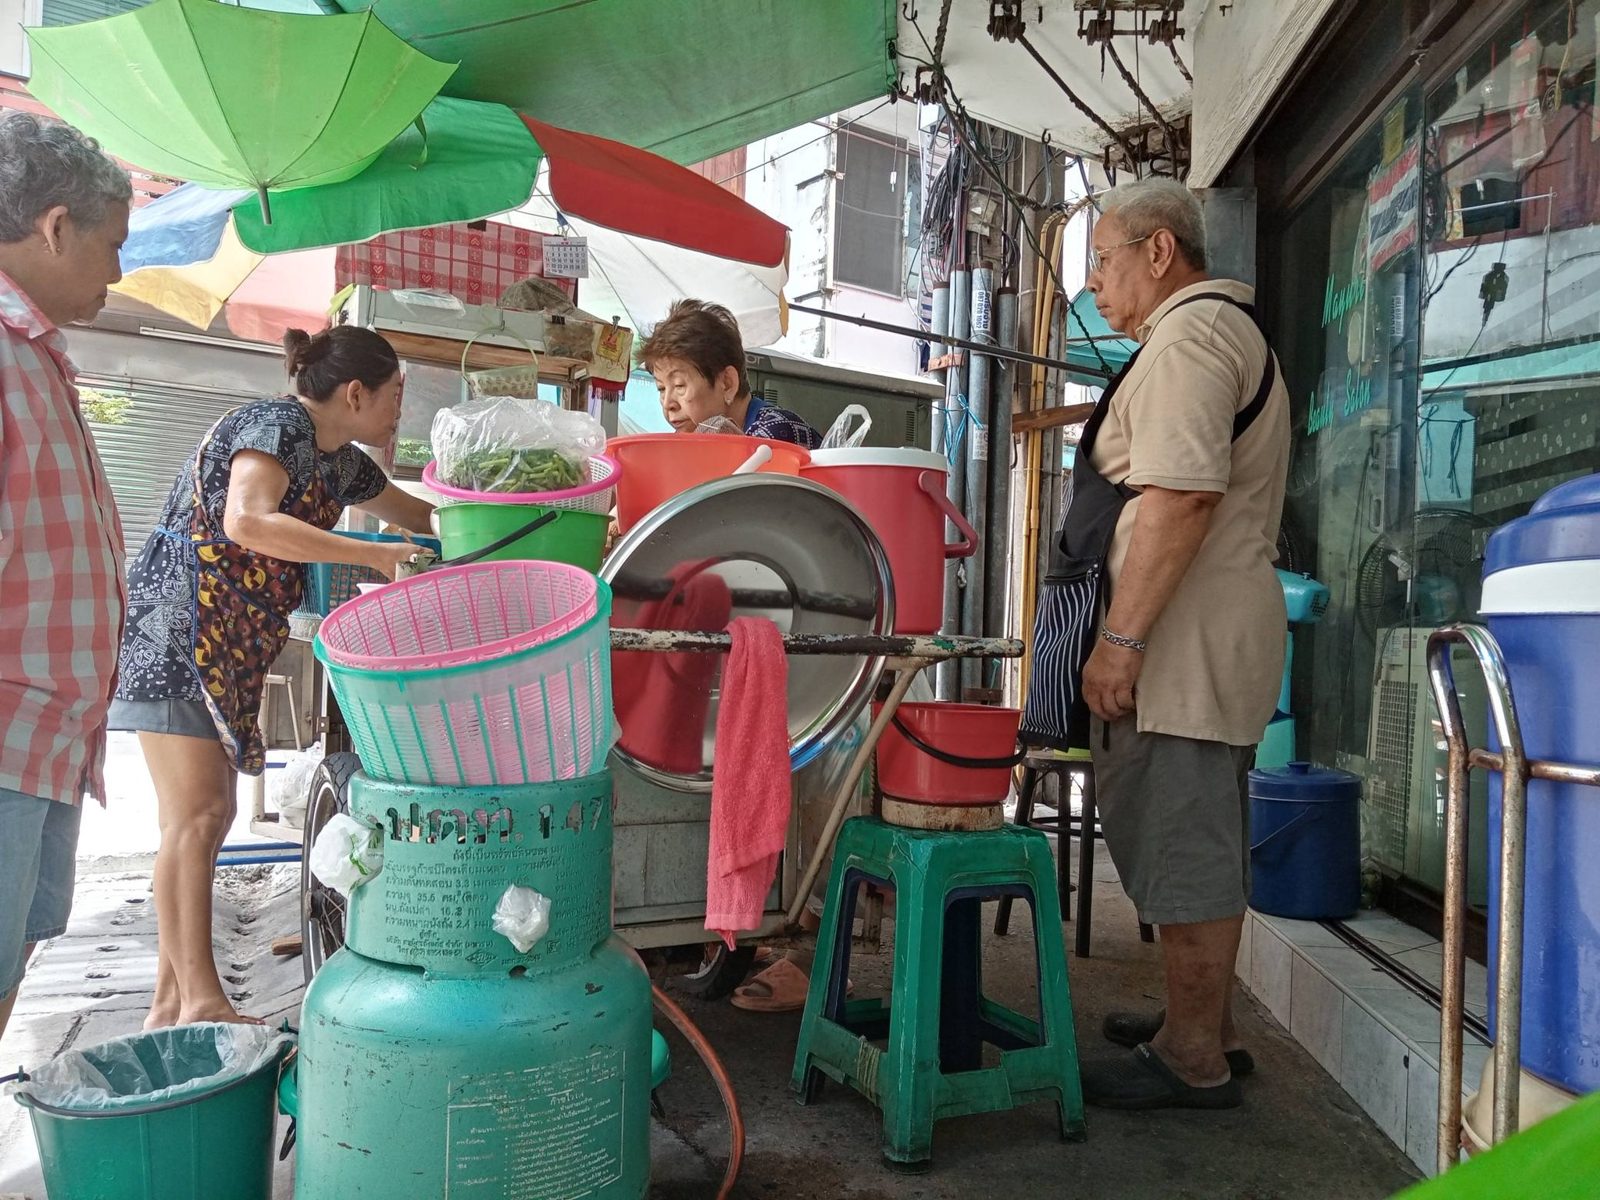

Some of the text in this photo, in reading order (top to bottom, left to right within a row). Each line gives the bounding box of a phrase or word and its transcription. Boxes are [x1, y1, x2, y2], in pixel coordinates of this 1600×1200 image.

[1344, 362, 1371, 417] Salon
[386, 798, 604, 844] ปตท. 147
